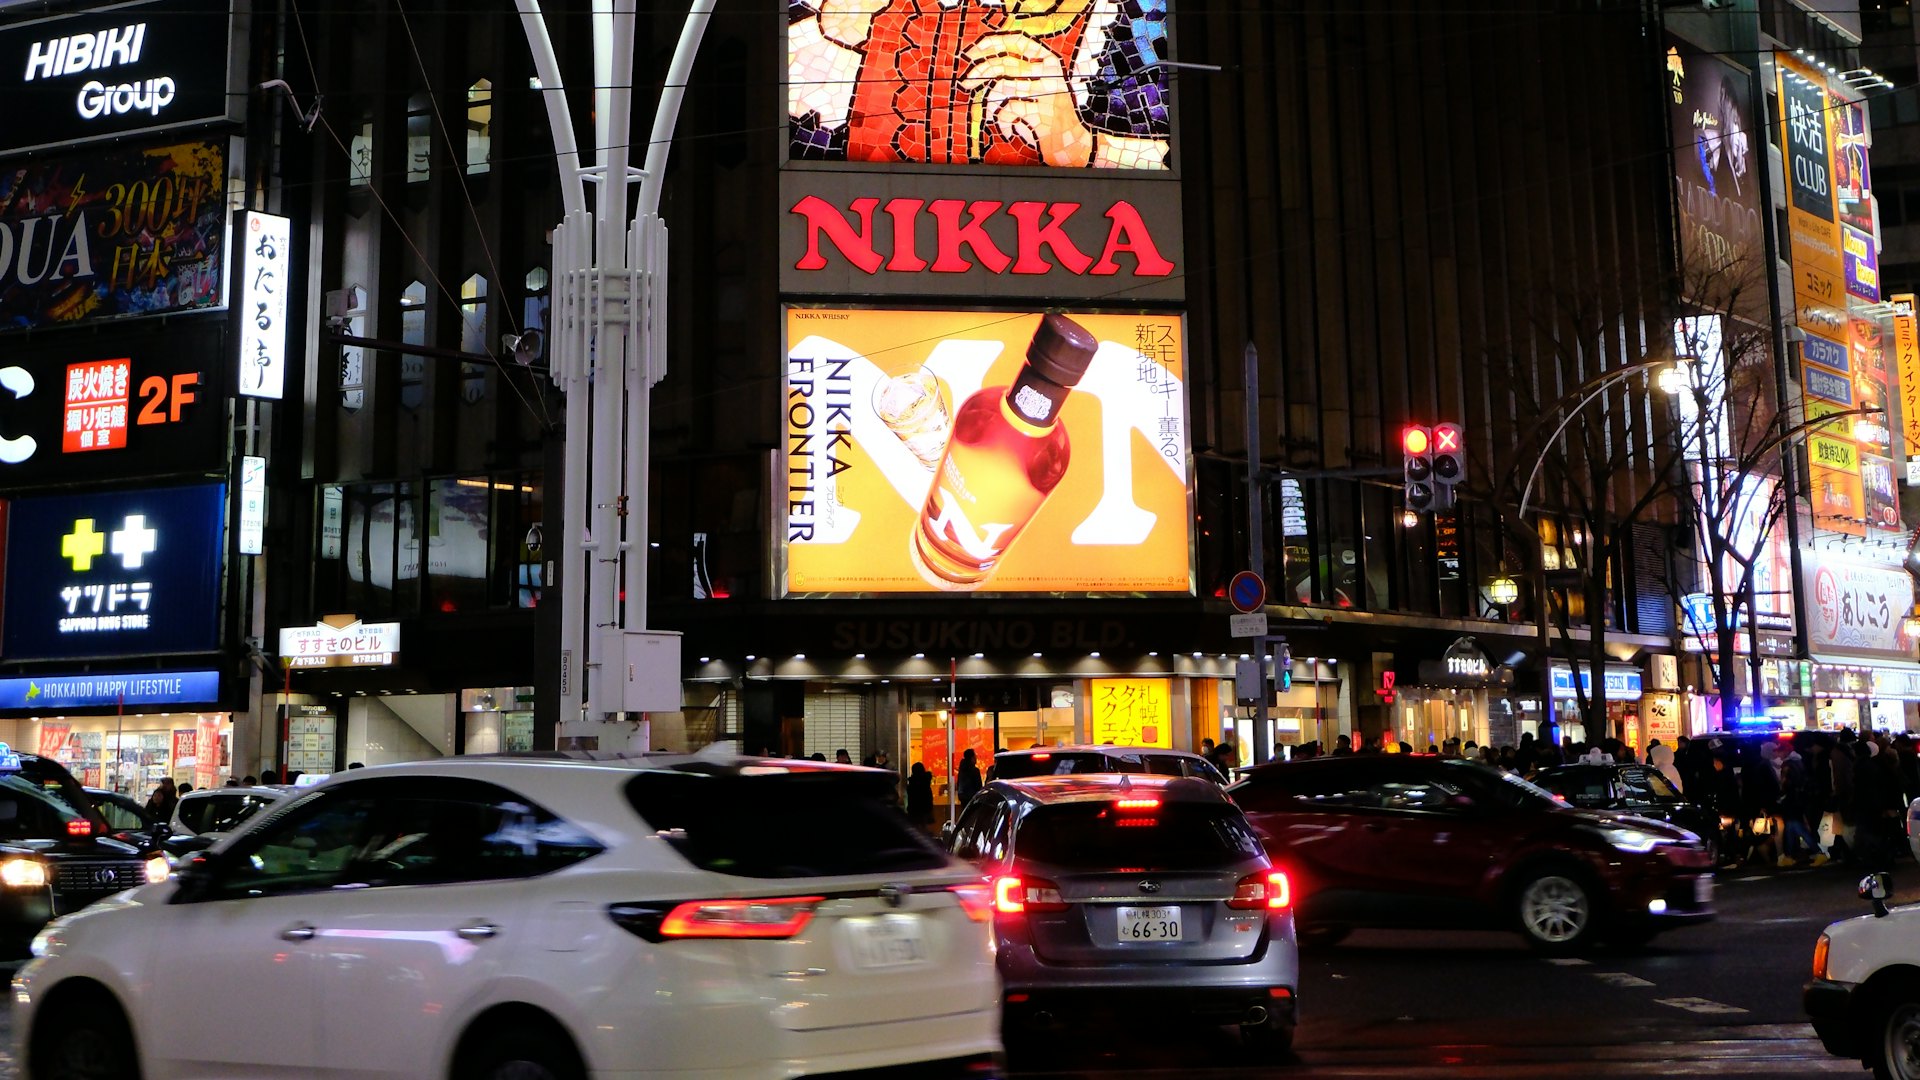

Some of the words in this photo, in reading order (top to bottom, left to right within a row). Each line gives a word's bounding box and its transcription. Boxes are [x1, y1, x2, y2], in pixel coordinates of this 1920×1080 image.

[24, 23, 146, 81] HIBIKI
[76, 76, 176, 119] Group
[1790, 96, 1823, 155] 快活
[1796, 154, 1827, 196] CLUB
[789, 194, 1177, 277] NIKKA
[1807, 272, 1832, 298] コミック
[1135, 323, 1158, 395] 新境地。
[1812, 340, 1840, 365] カラオケ
[67, 364, 128, 401] 炭火焼き
[137, 372, 198, 425] 2F
[66, 405, 126, 432] 掘り炬燵
[826, 357, 852, 479] NIKKA
[80, 430, 110, 448] 個室
[789, 357, 815, 543] FRONTIER
[61, 582, 152, 614] サツドラ
[1842, 586, 1889, 629] あしこう
[59, 615, 97, 633] SAPPORO
[122, 613, 150, 630] STORE
[832, 619, 1036, 651] SUSUKINO
[1050, 618, 1135, 650] BLD.
[298, 636, 382, 654] すすきのビル
[44, 682, 93, 699] HOKKAIDO
[96, 680, 127, 697] HAPPY
[131, 678, 181, 696] LIFESTYLE
[1138, 684, 1159, 725] 札幌
[177, 733, 194, 744] TAX
[1661, 721, 1675, 729] 入口
[177, 744, 194, 754] FREE
[1132, 921, 1178, 938] 66-30
[1151, 910, 1167, 918] 303
